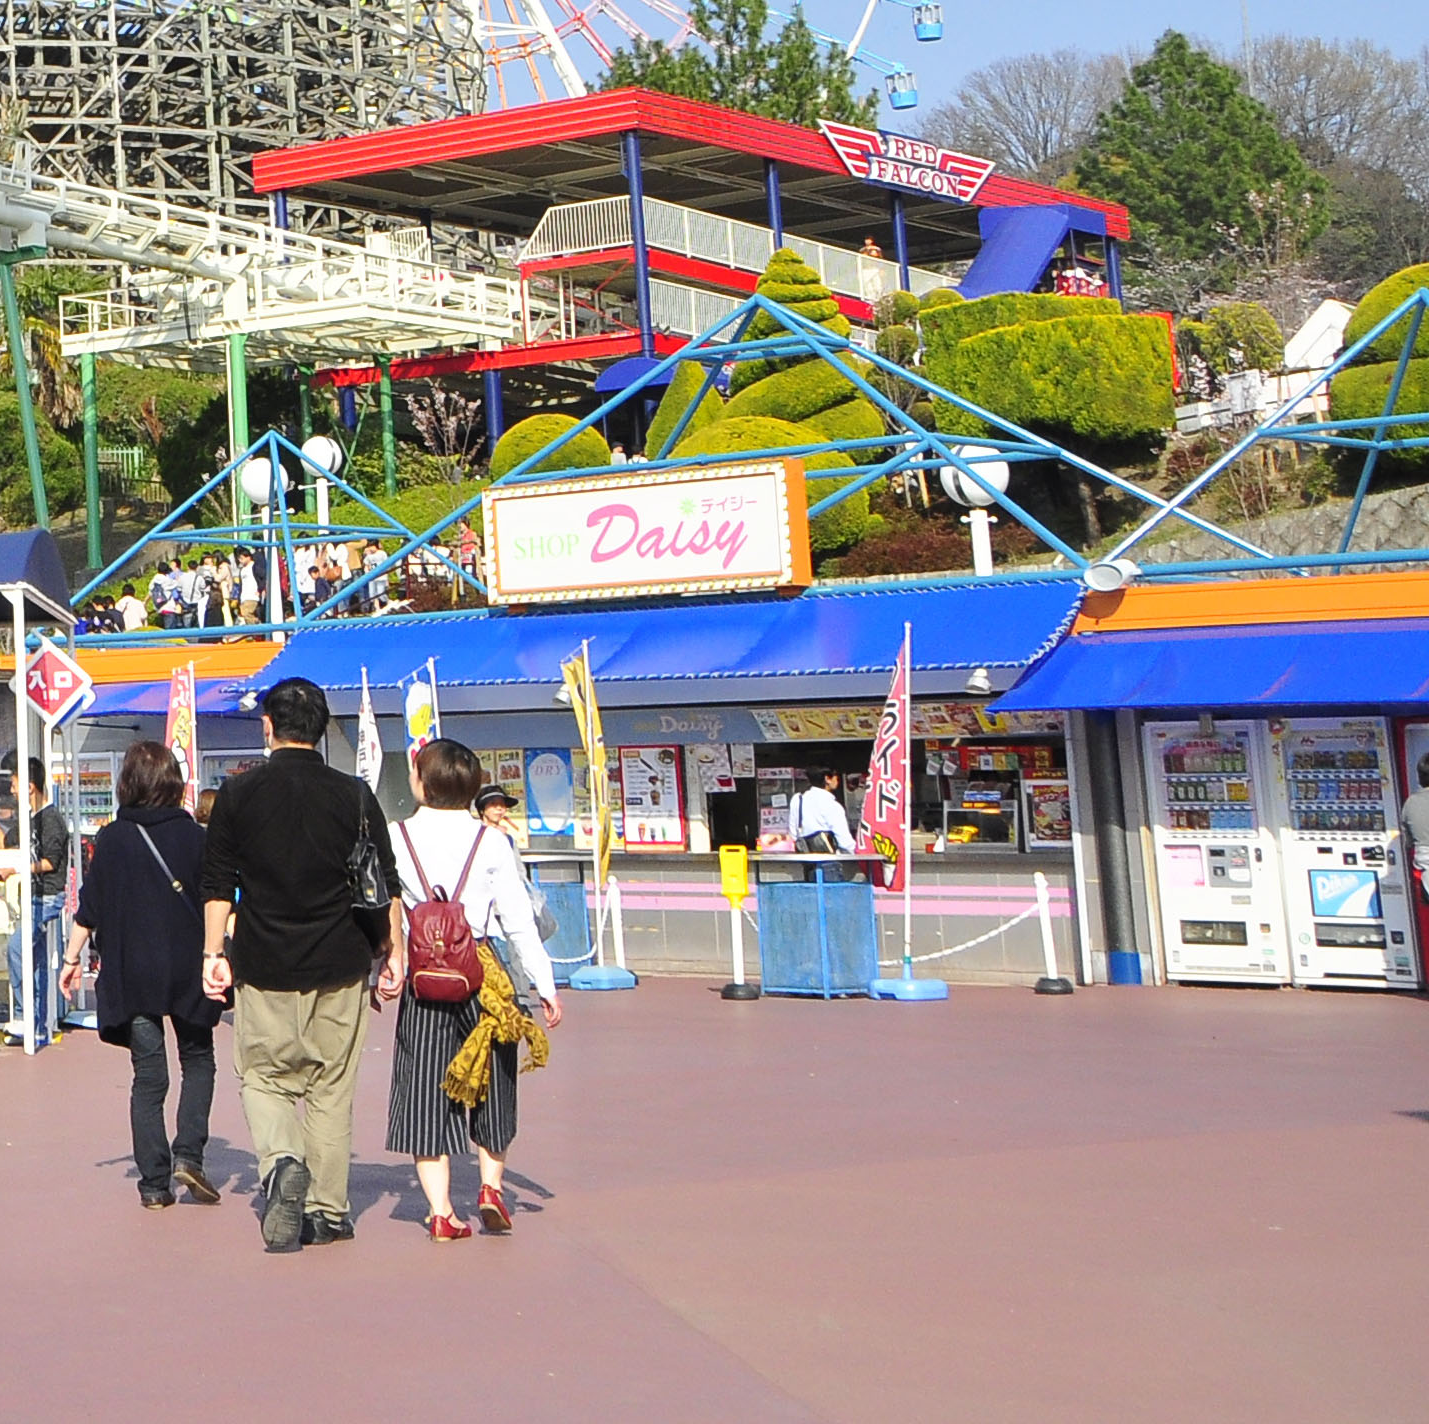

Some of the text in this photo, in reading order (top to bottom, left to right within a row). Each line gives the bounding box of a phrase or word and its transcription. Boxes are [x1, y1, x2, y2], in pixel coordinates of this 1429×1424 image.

[893, 138, 938, 165] RED
[876, 159, 959, 196] FALCON
[513, 502, 749, 570] SHOP Daisy
[28, 670, 73, 691] 入口
[42, 688, 60, 701] IN
[659, 715, 724, 740] Daisy
[534, 764, 562, 777] DRY
